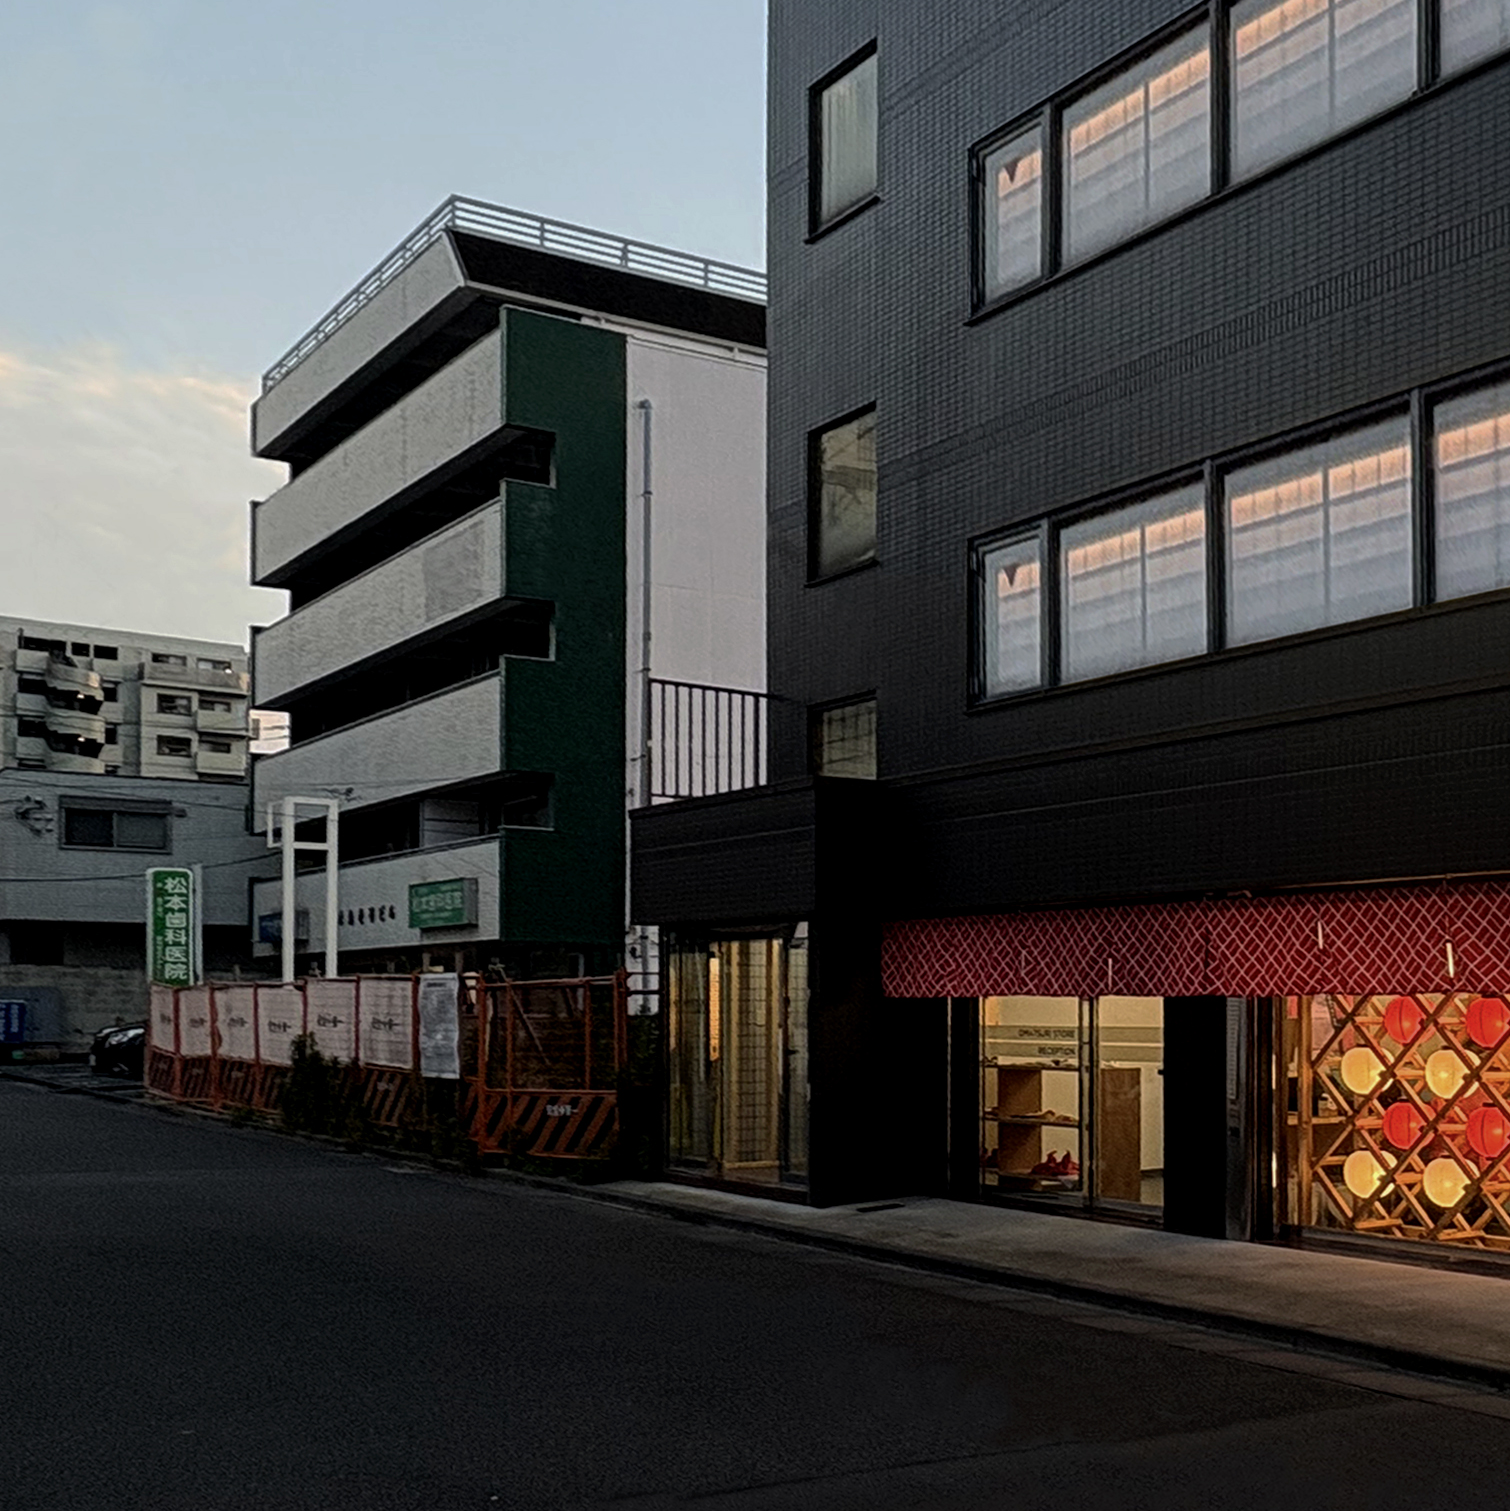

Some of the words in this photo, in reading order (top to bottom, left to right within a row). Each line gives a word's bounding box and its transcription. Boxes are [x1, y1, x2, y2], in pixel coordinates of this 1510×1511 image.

[164, 876, 188, 980] 松本歯科医院
